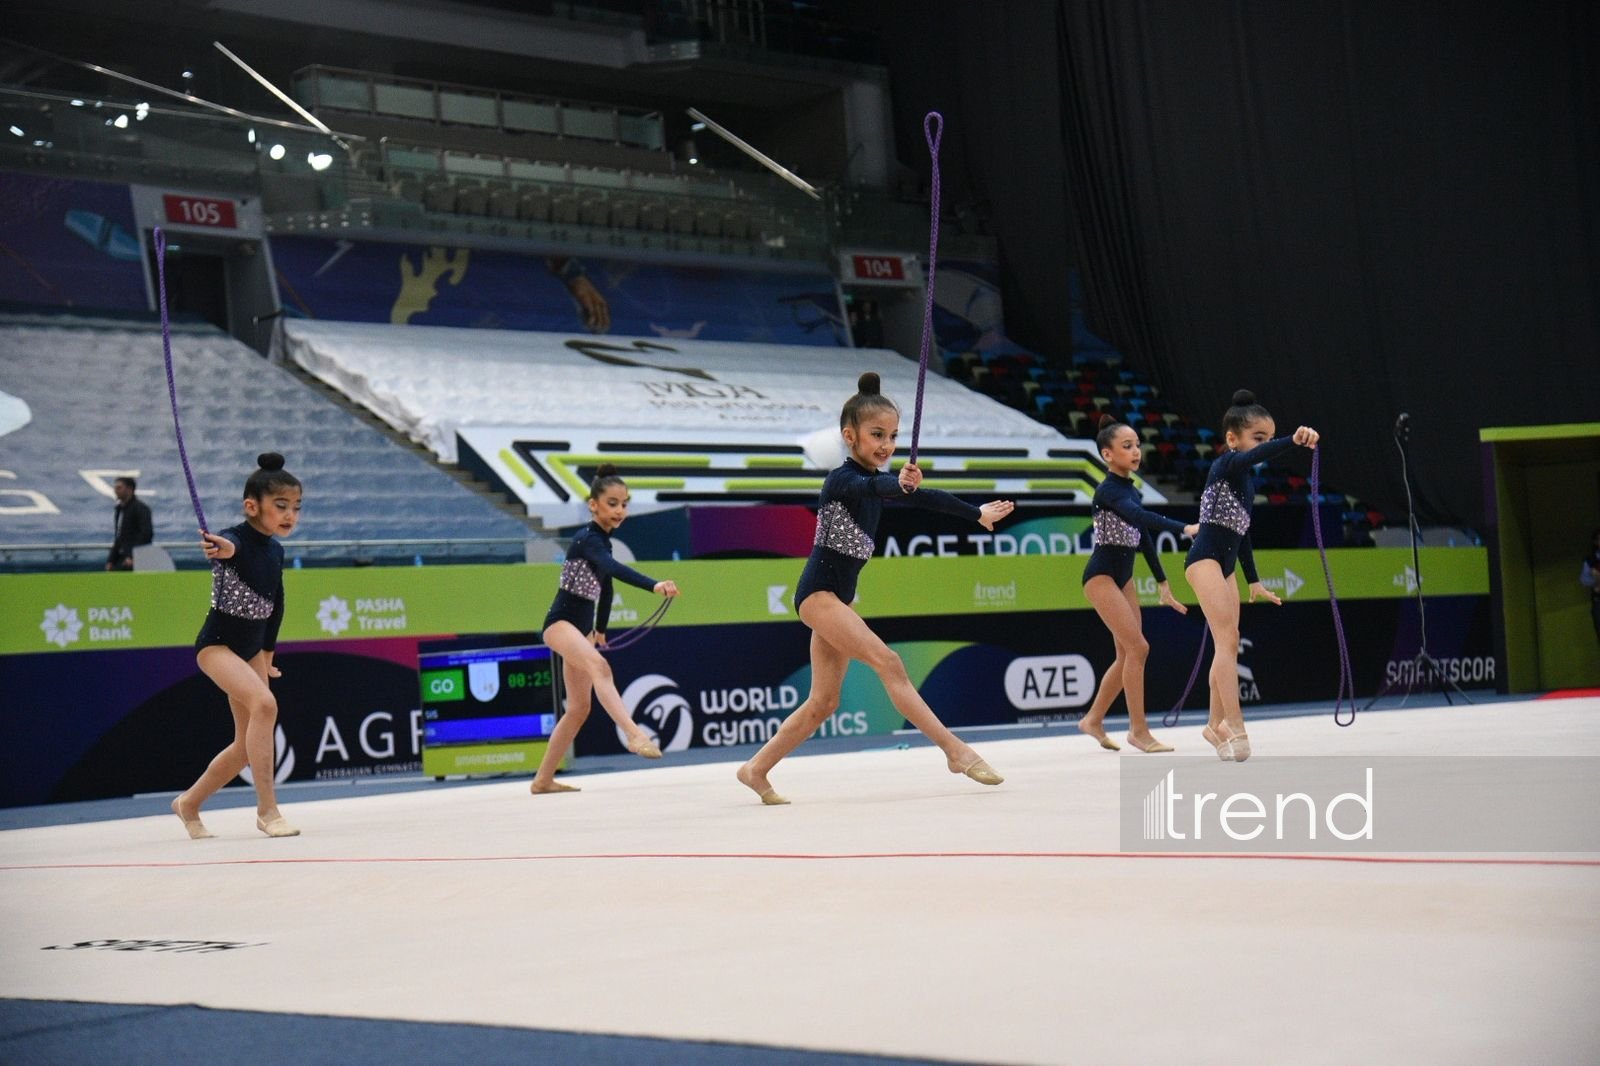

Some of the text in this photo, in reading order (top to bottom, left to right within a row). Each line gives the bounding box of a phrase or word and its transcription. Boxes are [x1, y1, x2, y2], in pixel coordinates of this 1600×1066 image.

[180, 200, 221, 224] 105
[863, 258, 893, 277] 104
[355, 598, 405, 613] PASHA
[88, 607, 133, 625] PAŞA
[358, 615, 407, 630] Travel
[89, 625, 132, 641] Bank
[430, 671, 551, 694] GO 00:25
[1023, 666, 1078, 699] AZE
[1239, 681, 1261, 701] GA
[700, 685, 798, 714] WORLD
